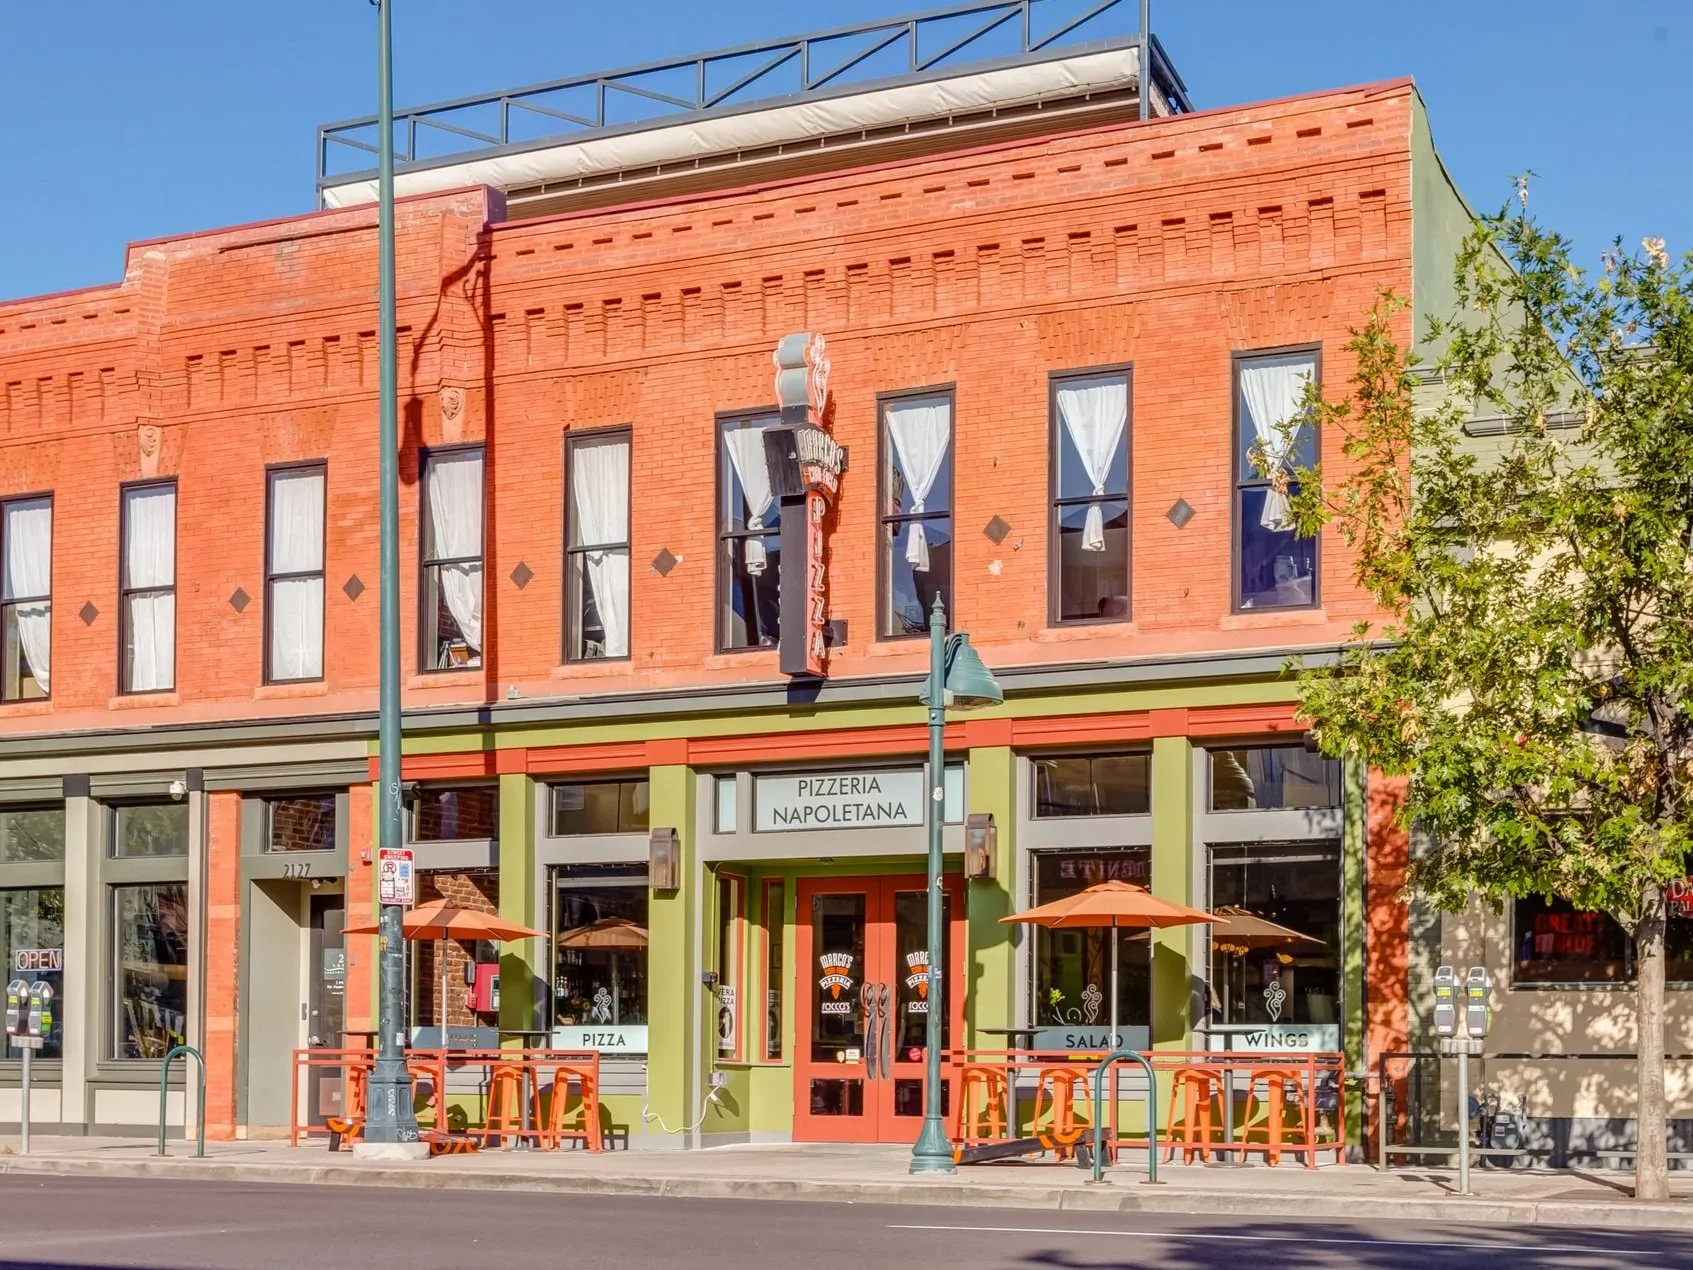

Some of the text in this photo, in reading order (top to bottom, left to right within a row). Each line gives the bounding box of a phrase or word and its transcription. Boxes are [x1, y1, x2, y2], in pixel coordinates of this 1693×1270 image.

[811, 496, 826, 659] PIZZA
[798, 776, 882, 797] PIZZERIA
[773, 802, 908, 824] NAPOLETANA
[283, 863, 311, 879] 2127
[18, 951, 60, 969] OPEN
[820, 953, 853, 969] MARCO'S
[821, 975, 851, 989] PIZZERIA
[908, 974, 928, 988] PIZZE
[582, 1033, 626, 1047] PIZZA
[1066, 1034, 1124, 1048] SALAD
[1245, 1033, 1309, 1048] WINGS
